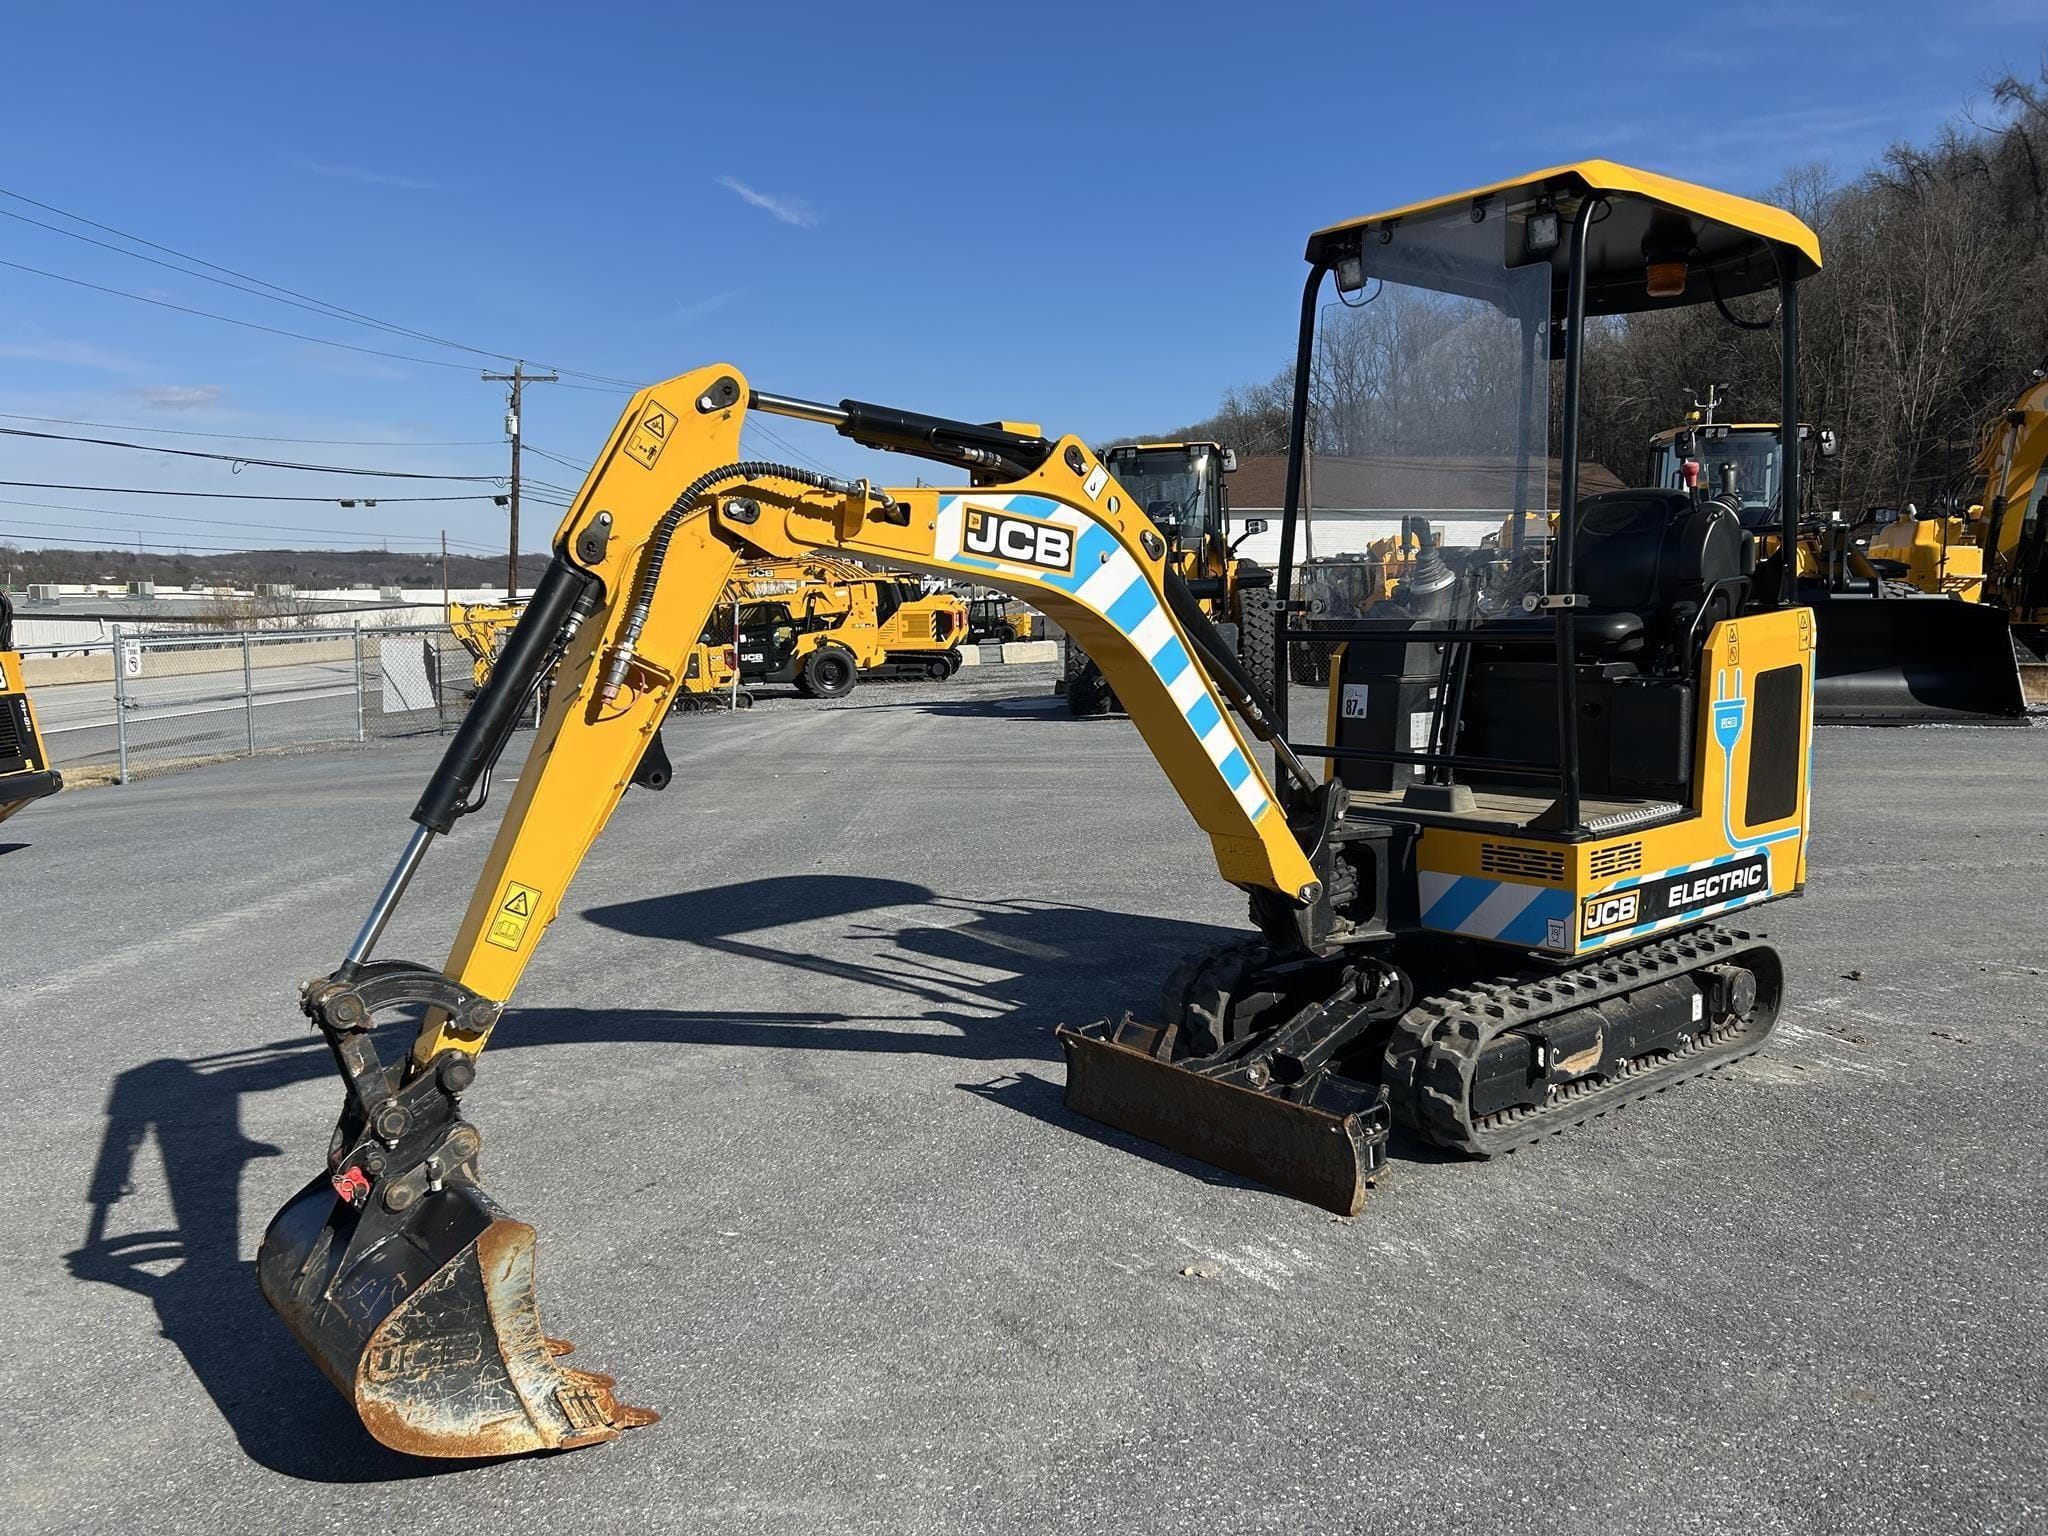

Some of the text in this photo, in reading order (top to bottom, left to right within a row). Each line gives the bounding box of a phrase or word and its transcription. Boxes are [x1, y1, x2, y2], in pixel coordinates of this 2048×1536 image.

[967, 516, 1070, 567] JCB
[748, 568, 774, 577] JCB
[741, 653, 764, 662] JCB
[1345, 699, 1358, 715] 87
[1722, 718, 1737, 728] JCB
[1587, 864, 1762, 929] JCB ELECTRIC
